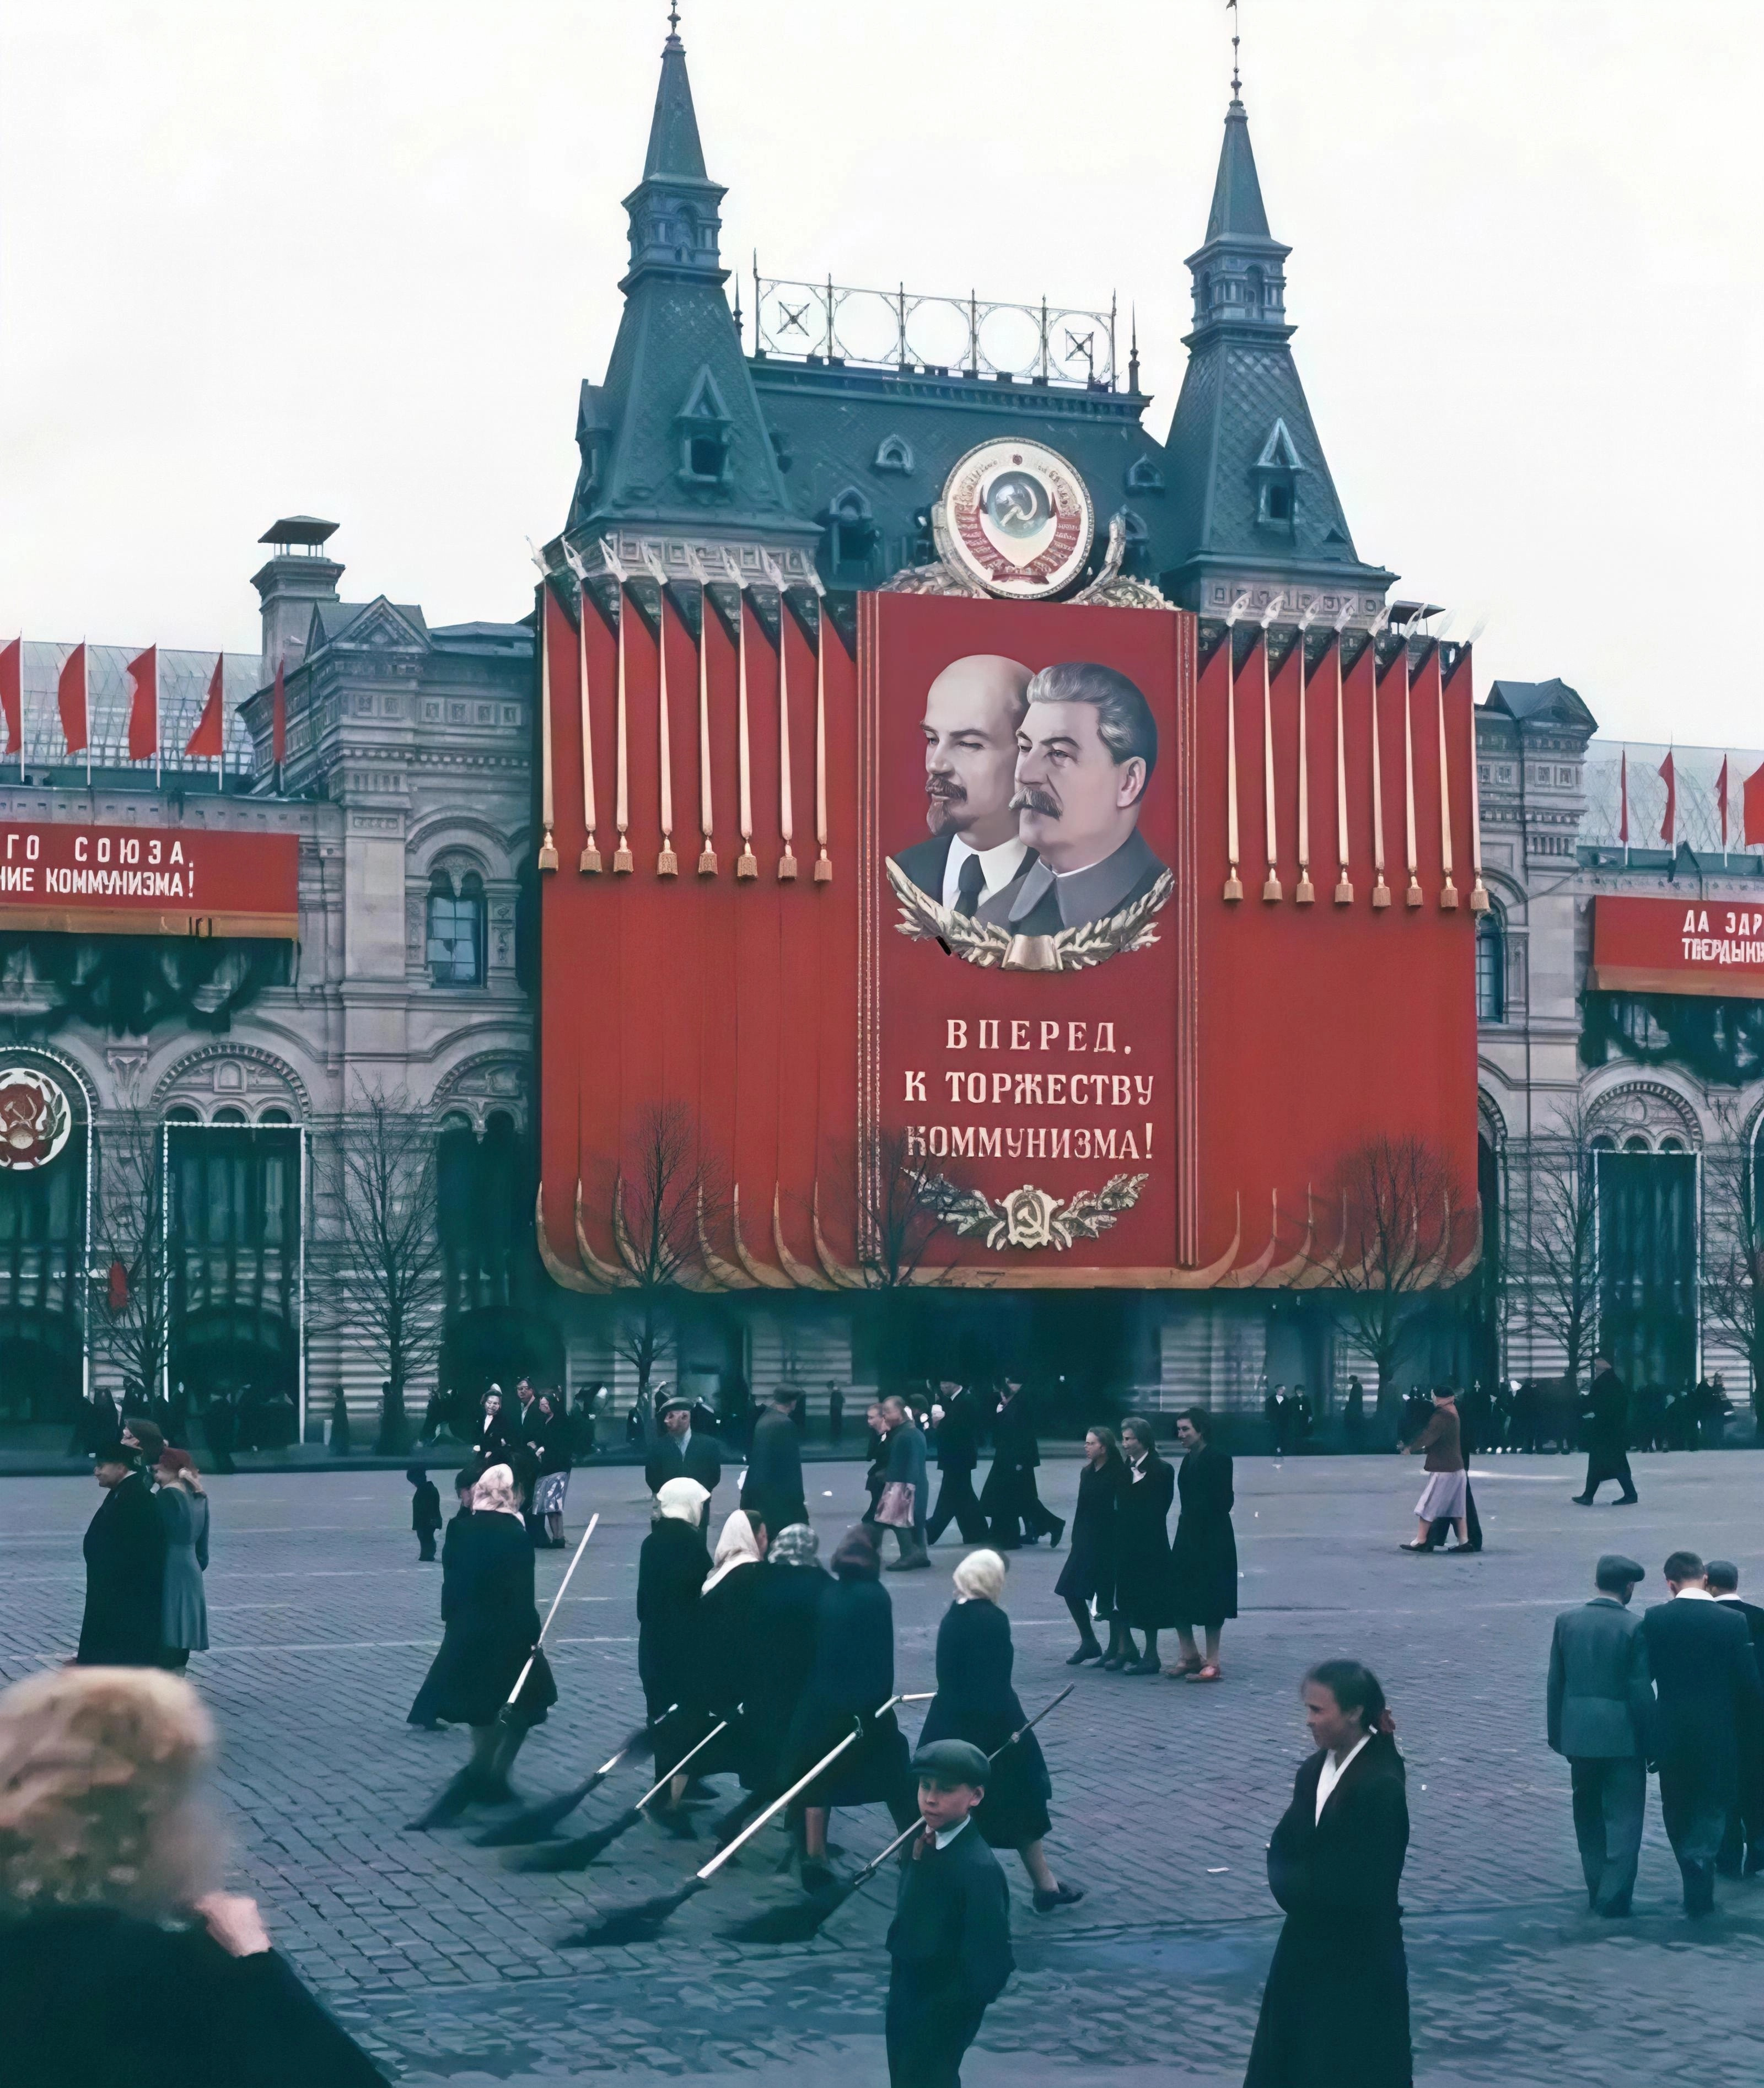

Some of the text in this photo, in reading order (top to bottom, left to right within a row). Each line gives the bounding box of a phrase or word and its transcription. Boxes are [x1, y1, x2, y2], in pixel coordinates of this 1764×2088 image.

[1682, 910, 1709, 933] ДА
[903, 1071, 1154, 1106] К ТОРЖЕСТВУ
[905, 1123, 1153, 1159] КОММУНИЗМА!
